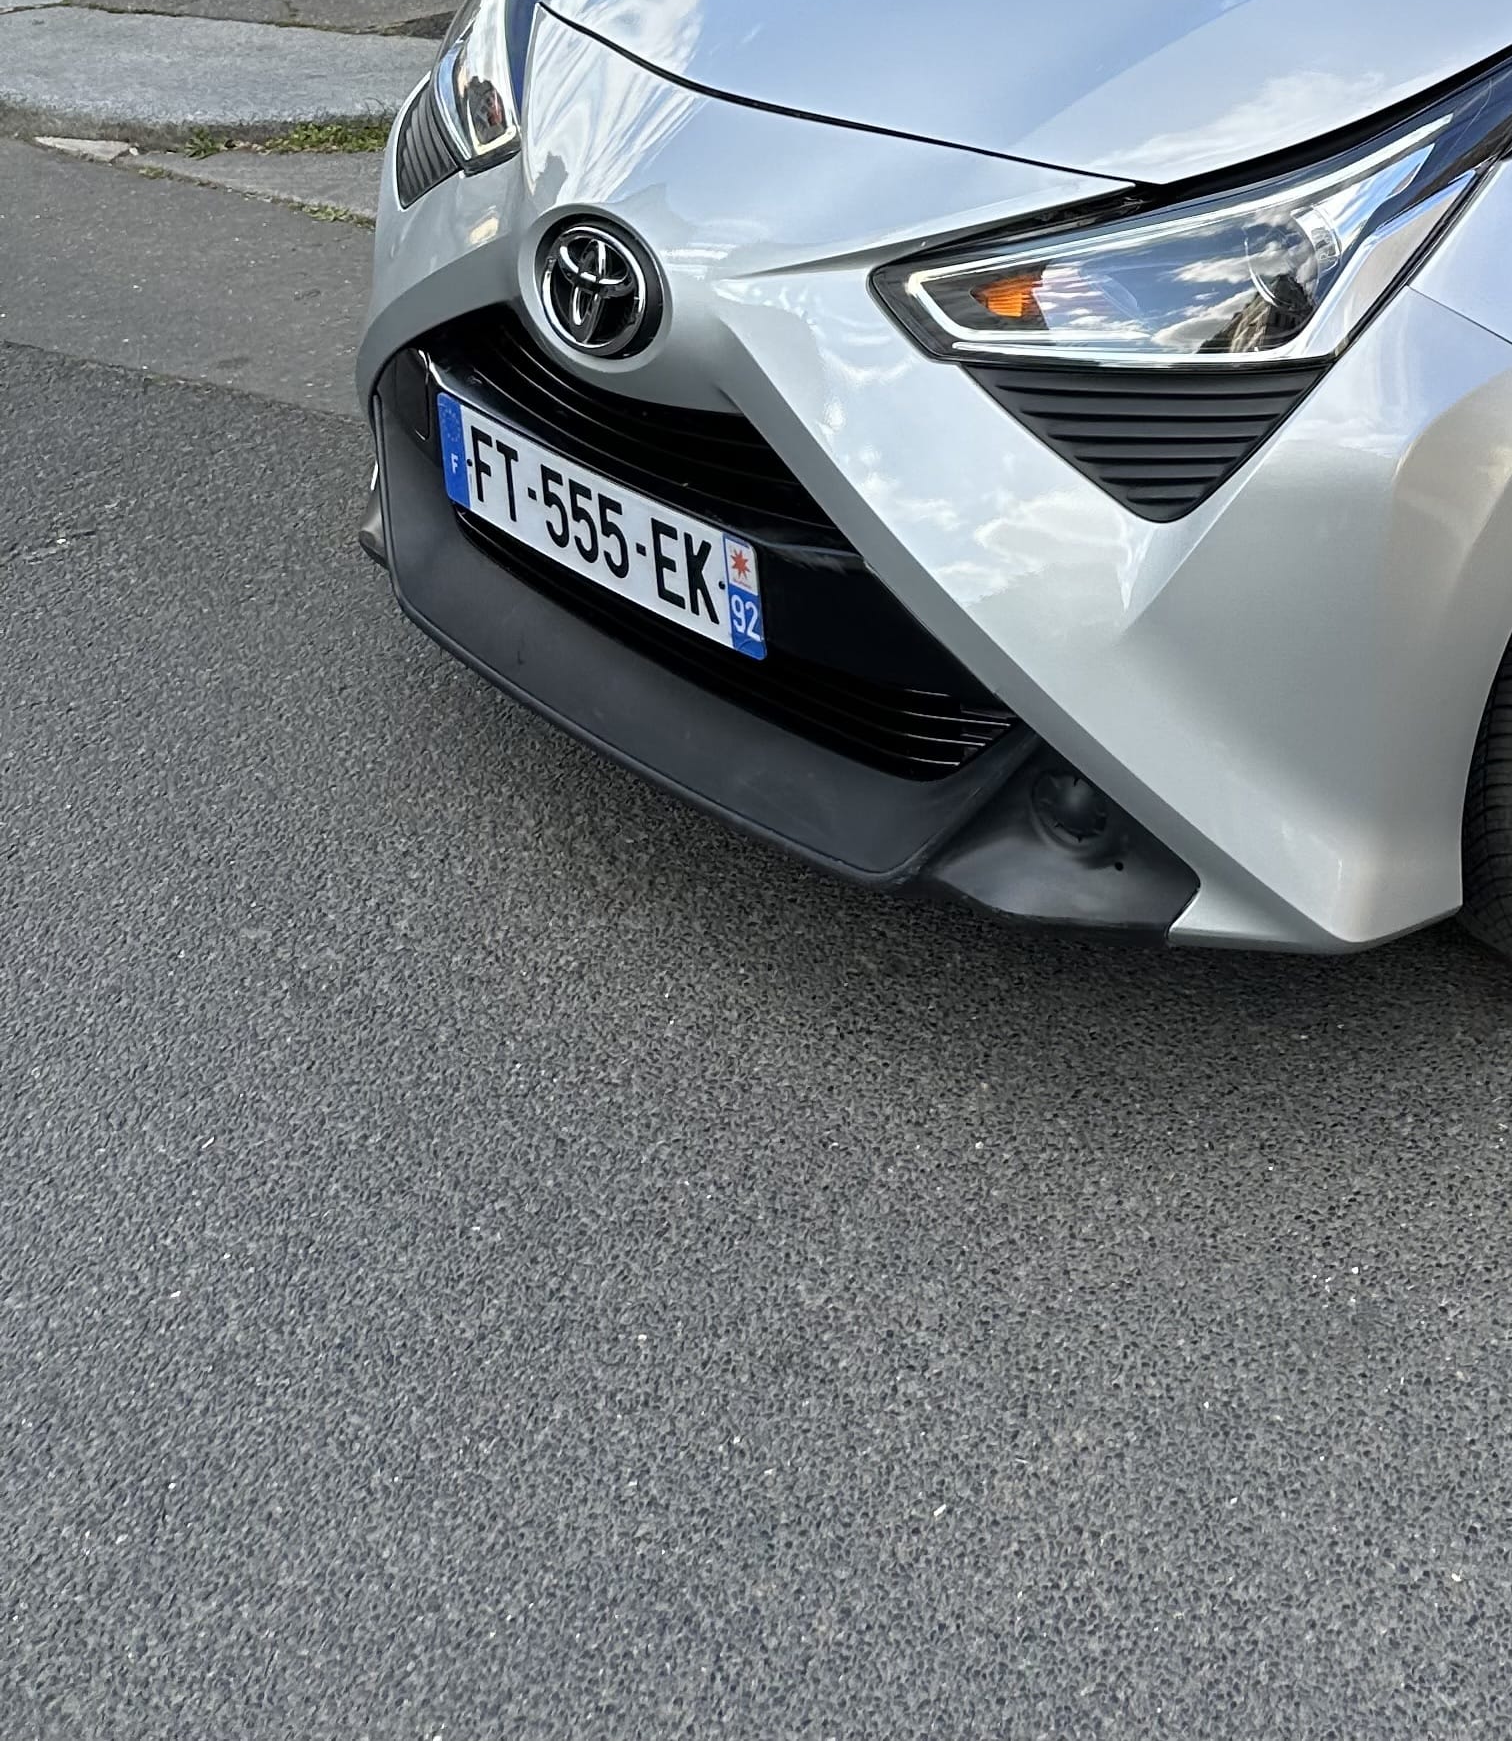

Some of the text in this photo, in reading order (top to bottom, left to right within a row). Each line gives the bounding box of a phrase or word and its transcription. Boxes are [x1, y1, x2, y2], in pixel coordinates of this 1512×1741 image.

[451, 453, 459, 473] F
[471, 425, 720, 626] FT-555-EK
[731, 594, 761, 643] 92
